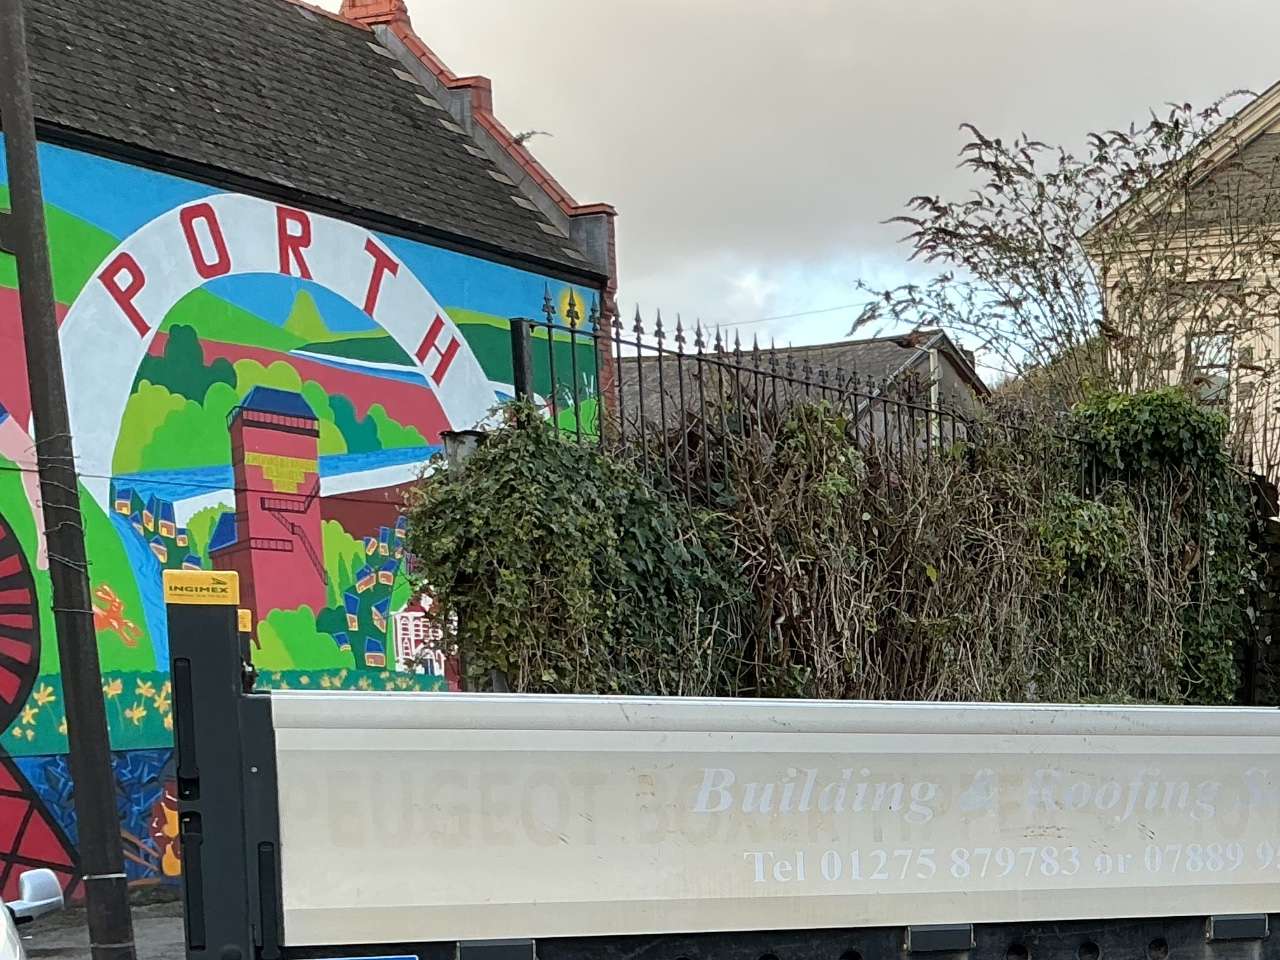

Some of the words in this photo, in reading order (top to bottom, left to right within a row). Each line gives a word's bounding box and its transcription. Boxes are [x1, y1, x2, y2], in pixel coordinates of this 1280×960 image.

[97, 202, 461, 386] PORTH
[168, 585, 230, 594] INGIMEX
[692, 767, 940, 824] Building
[1026, 767, 1222, 821] Roofing
[744, 850, 806, 882] Tel
[820, 849, 938, 881] 01275
[949, 846, 1081, 879] 879783
[1094, 852, 1133, 875] or
[1143, 843, 1244, 874] 07889
